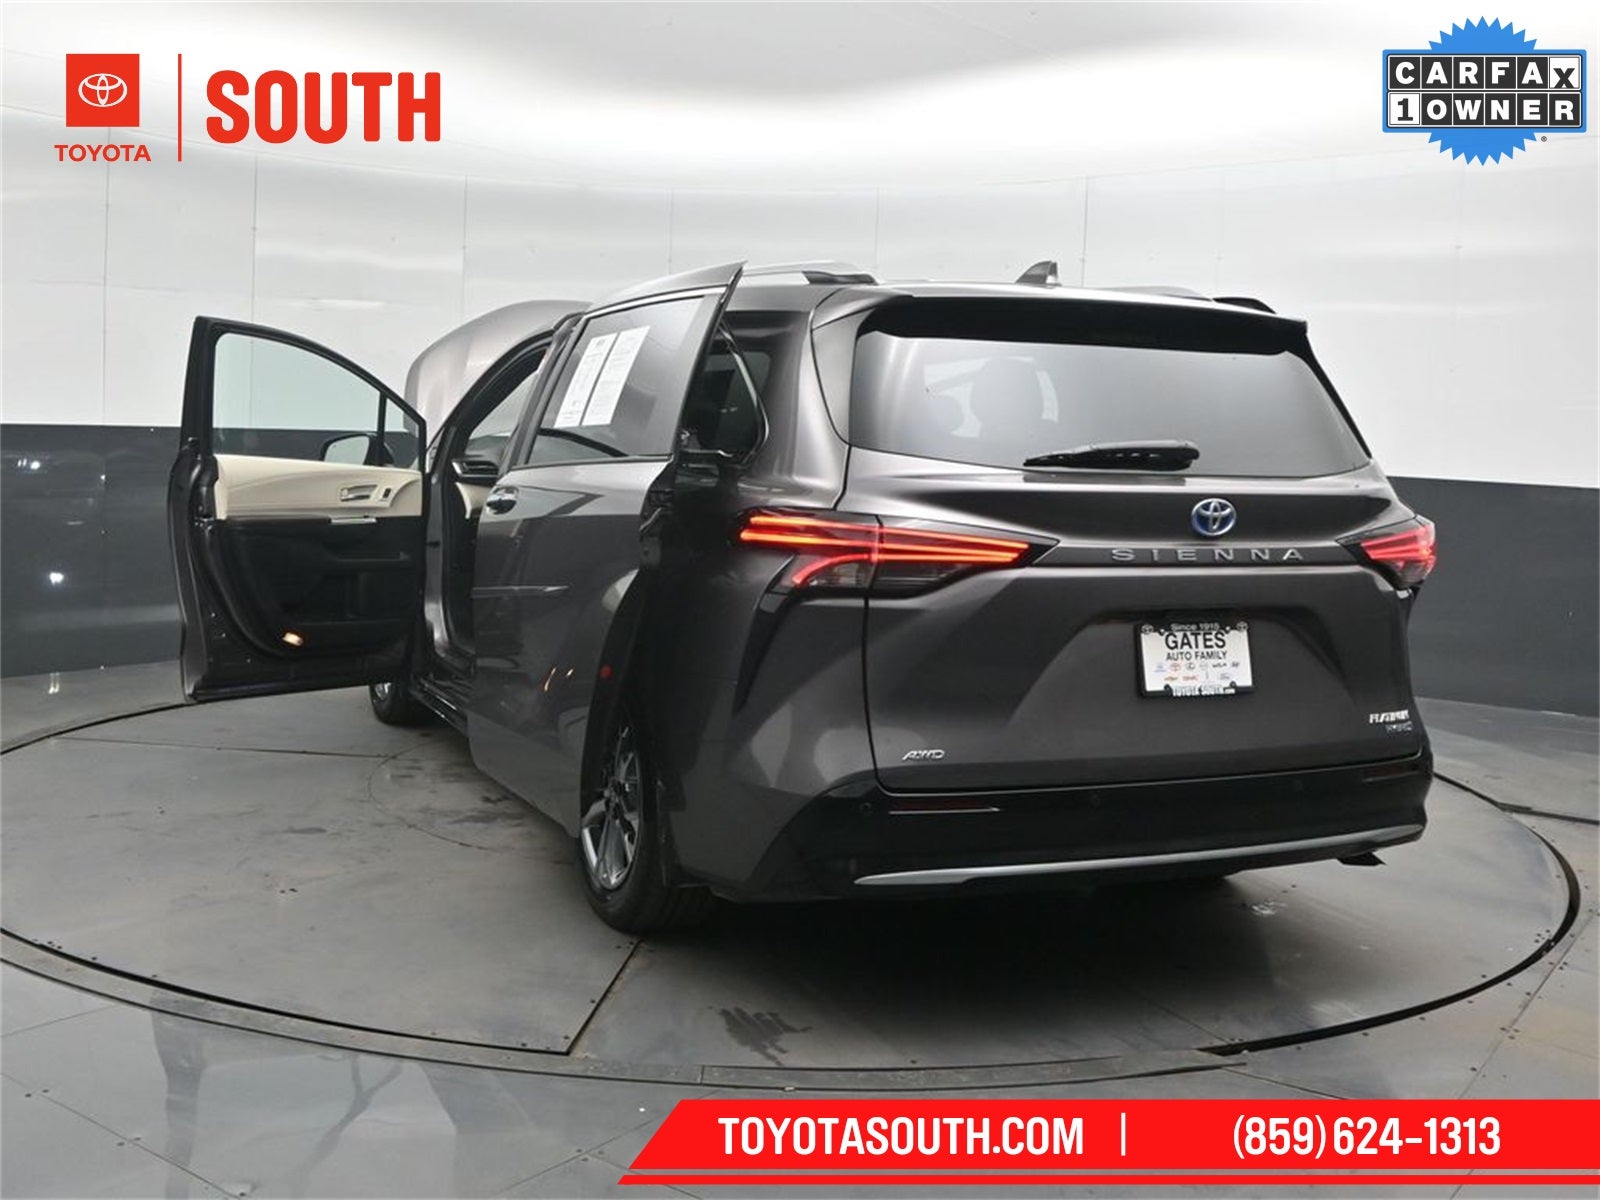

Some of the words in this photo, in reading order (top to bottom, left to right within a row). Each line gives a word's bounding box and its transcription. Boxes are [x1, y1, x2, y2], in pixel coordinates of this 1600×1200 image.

[1111, 548, 1304, 561] SIENNA
[1171, 623, 1197, 632] Since
[1165, 632, 1226, 650] GATES
[1166, 651, 1192, 661] AUTO
[1195, 650, 1228, 660] FAMILY
[902, 748, 945, 761] AWD
